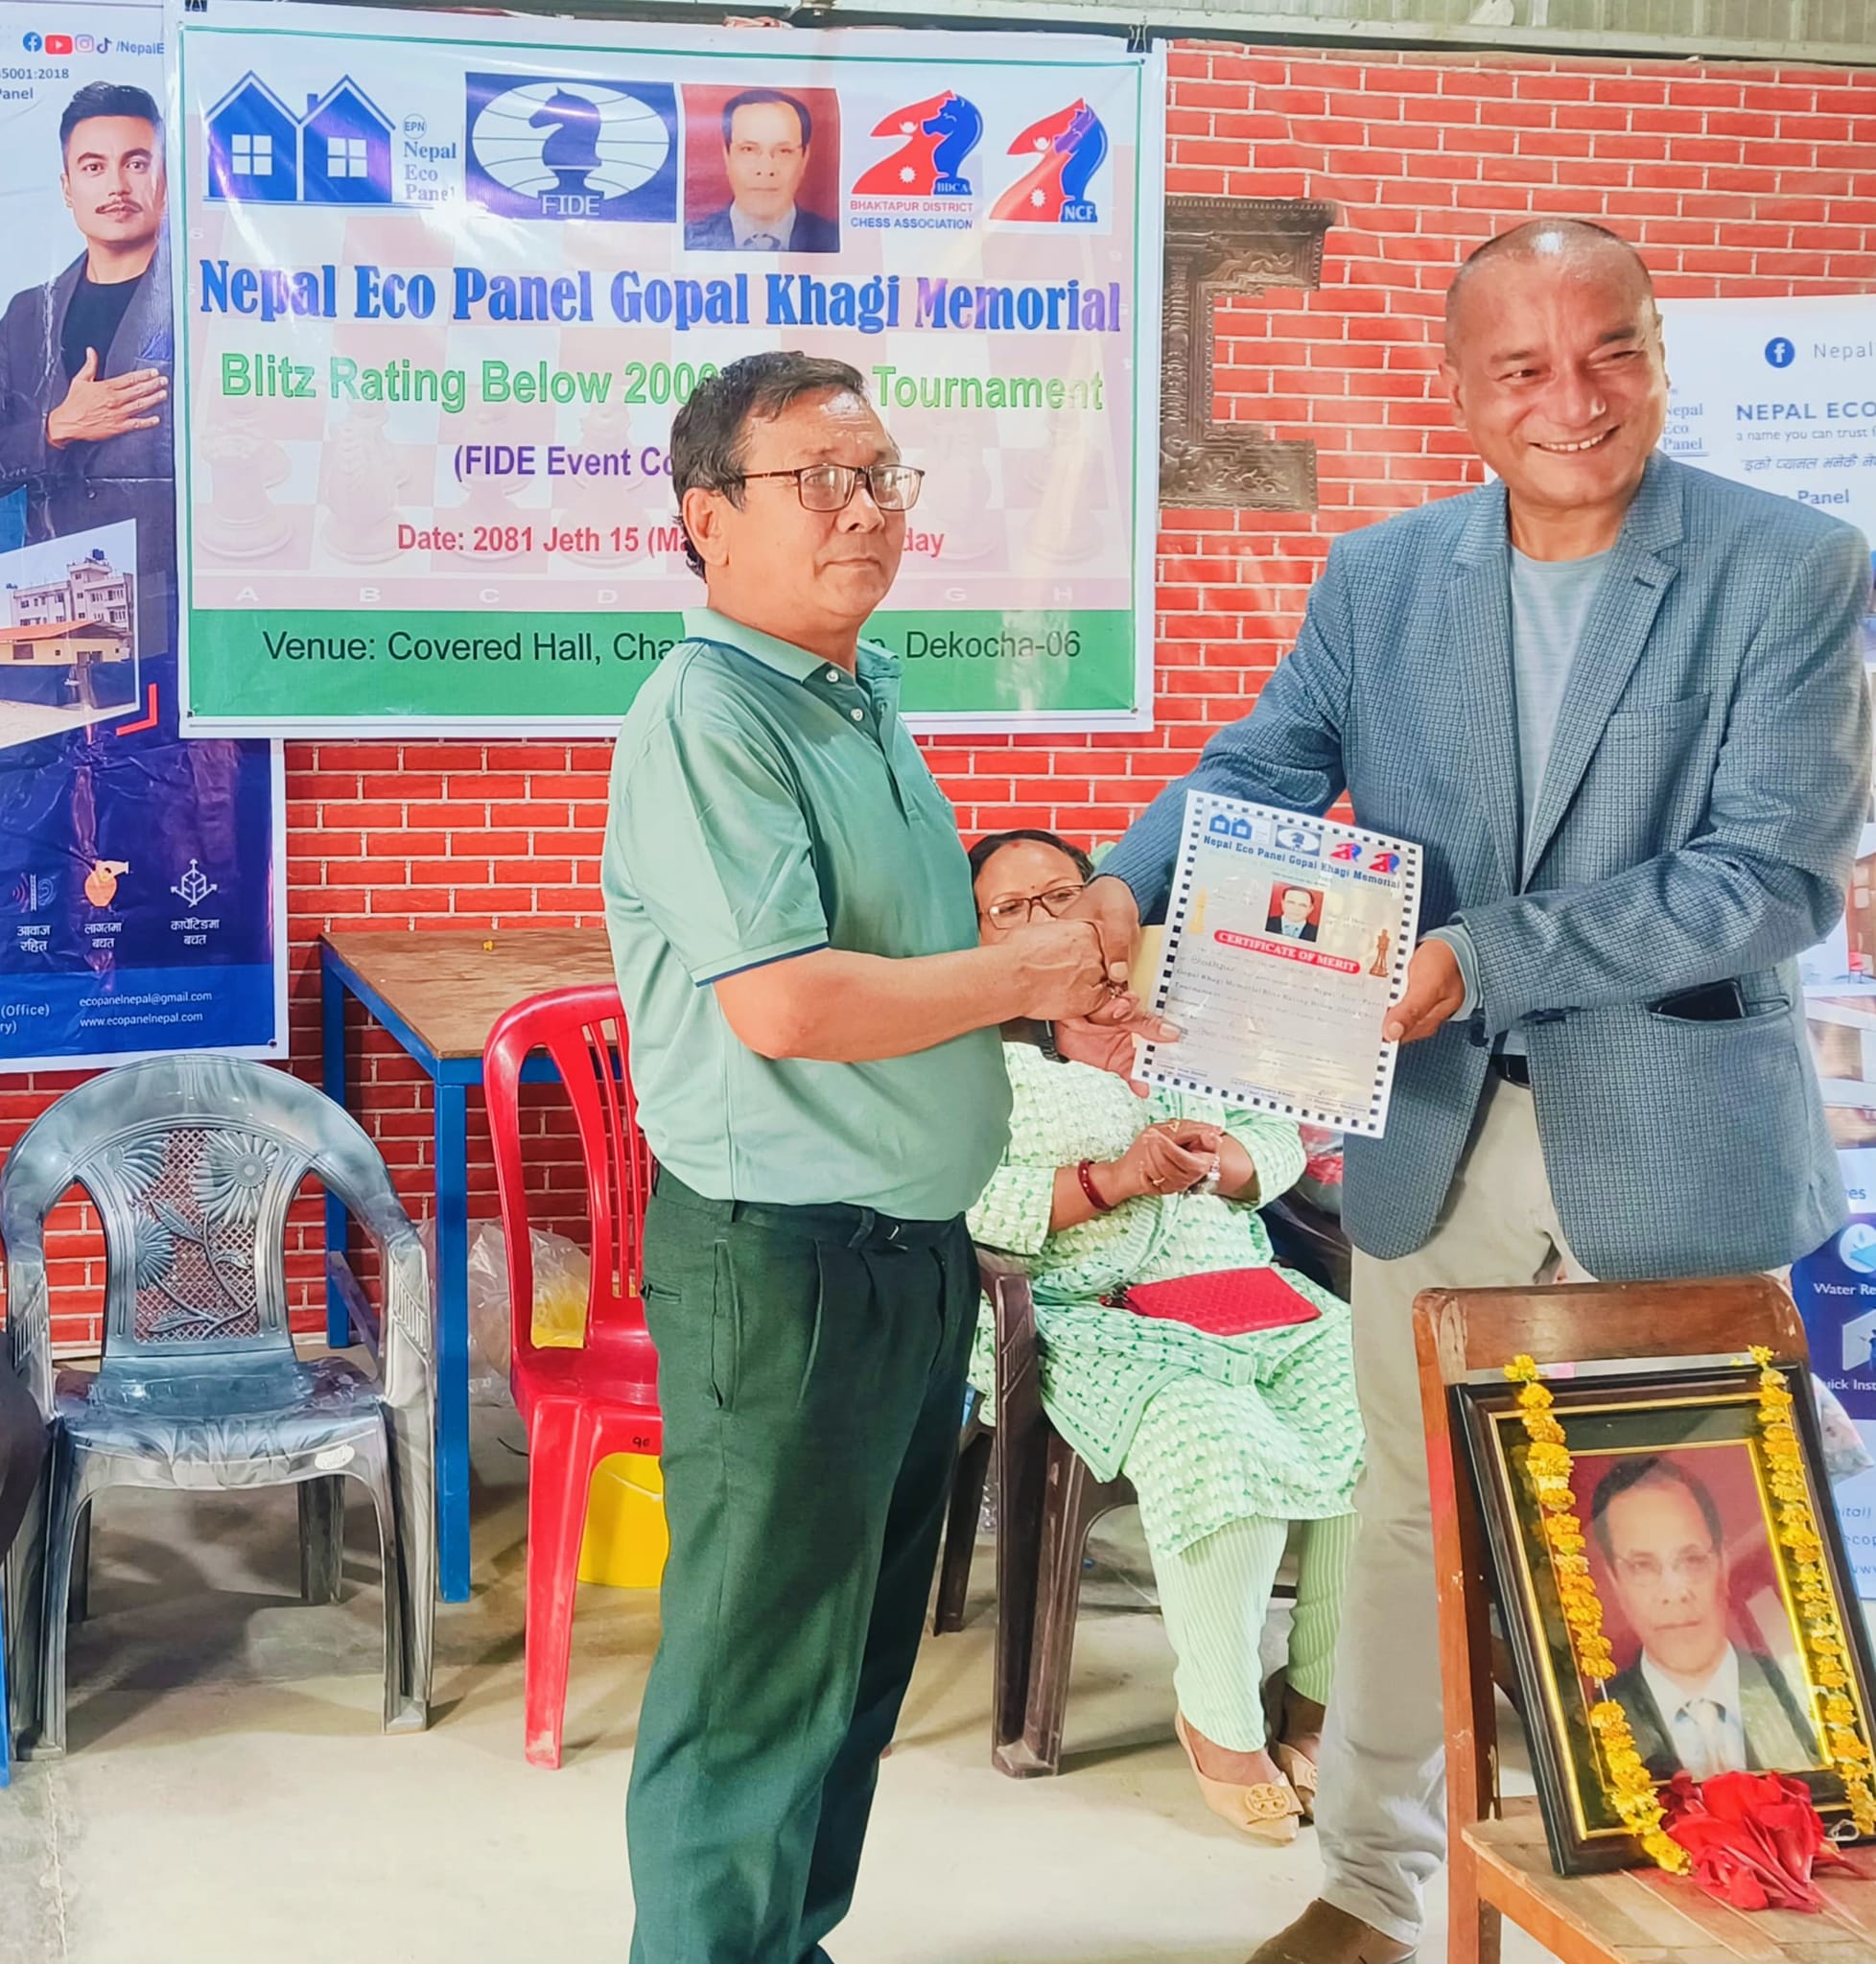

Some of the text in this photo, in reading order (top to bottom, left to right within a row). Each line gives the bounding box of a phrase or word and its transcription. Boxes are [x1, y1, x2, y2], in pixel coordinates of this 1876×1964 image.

[0, 68, 70, 81] 5001:2018
[0, 86, 34, 100] anel
[404, 121, 425, 131] EPN
[404, 141, 457, 162] Nepal
[405, 164, 438, 181] Eco
[542, 196, 600, 216] FIDE
[850, 199, 973, 213] BHAKTAPUR DISTRICT
[1065, 204, 1095, 222] NCF
[851, 218, 973, 230] CHESS ASSOCIATION
[199, 259, 1121, 334] Nepal Eco Panel Gopal Khagi Memorial
[1814, 340, 1876, 362] Nepal
[221, 352, 317, 398] Blitz
[329, 355, 466, 414] Rating
[481, 360, 613, 404] Below
[872, 365, 1104, 410] Tournament
[1736, 401, 1876, 421] NEPAL ECO
[1747, 432, 1780, 441] name
[1785, 432, 1807, 442] you
[1812, 430, 1833, 439] can
[1838, 428, 1867, 438] trust
[454, 444, 536, 483] (FIDE
[548, 446, 632, 477] Event
[1797, 488, 1850, 505] Panel
[397, 524, 465, 552] Date:
[473, 525, 533, 552] 2081
[543, 526, 600, 552] Jeth
[611, 526, 640, 552] 15
[903, 527, 945, 558] day
[262, 630, 376, 661] Venue:
[387, 630, 524, 661] Covered
[533, 631, 602, 666] Hall,
[613, 632, 685, 661] Cha
[905, 630, 1081, 659] Dekocha-06
[1204, 835, 1233, 850] Nepal
[1235, 842, 1255, 853] Eco
[1257, 847, 1286, 862] Panel
[1289, 854, 1318, 870] Gopal
[1219, 931, 1357, 972] CERTIFICATE OF MERIT
[80, 991, 213, 1008] ecopanelnepal@gmail.com
[1, 1003, 50, 1019] (Office)
[0, 1020, 16, 1035] ry)
[80, 1013, 203, 1028] www.ecopanelnepal.com
[1813, 1282, 1876, 1296] Water Re
[1826, 1378, 1876, 1391] uick Inst
